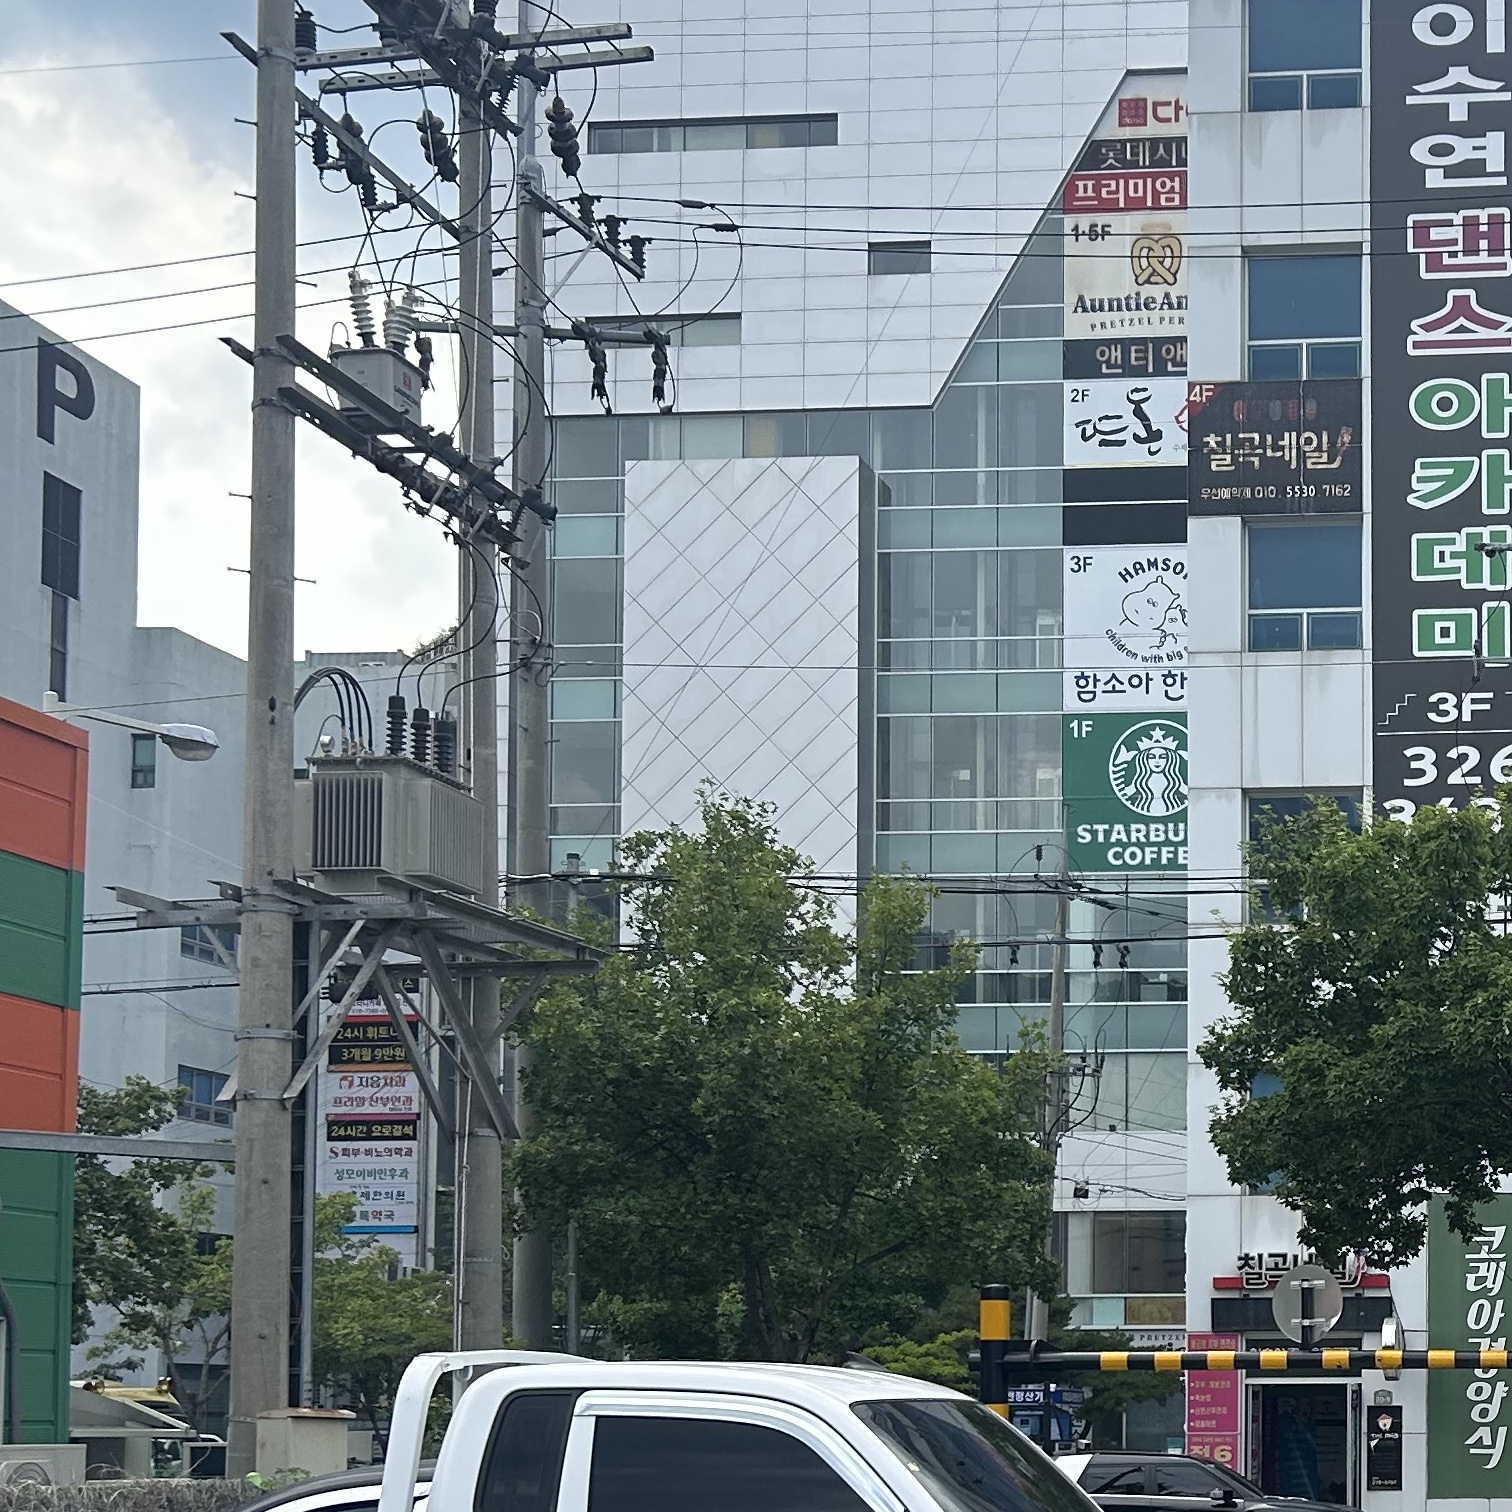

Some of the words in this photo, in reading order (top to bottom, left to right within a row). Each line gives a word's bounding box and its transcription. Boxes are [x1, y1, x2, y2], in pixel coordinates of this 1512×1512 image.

[1152, 97, 1187, 123] 다
[1073, 176, 1180, 208] 프리미엄
[1090, 316, 1153, 332] PRETZEL
[37, 336, 95, 446] P
[1070, 389, 1090, 402] 2F
[1189, 385, 1214, 403] 4F
[1203, 432, 1342, 471] 칠곡네일
[1070, 556, 1093, 573] 3F
[1105, 628, 1138, 661] children
[1141, 653, 1164, 664] with
[1167, 650, 1184, 662] big
[1074, 671, 1154, 703] 함소아
[1161, 671, 1188, 702] 한
[1427, 692, 1494, 723] 3F
[1069, 720, 1094, 738] 1F
[331, 1126, 367, 1137] 24시간
[335, 1167, 409, 1181] 성모이비인후과
[352, 1190, 406, 1201] 제한의원
